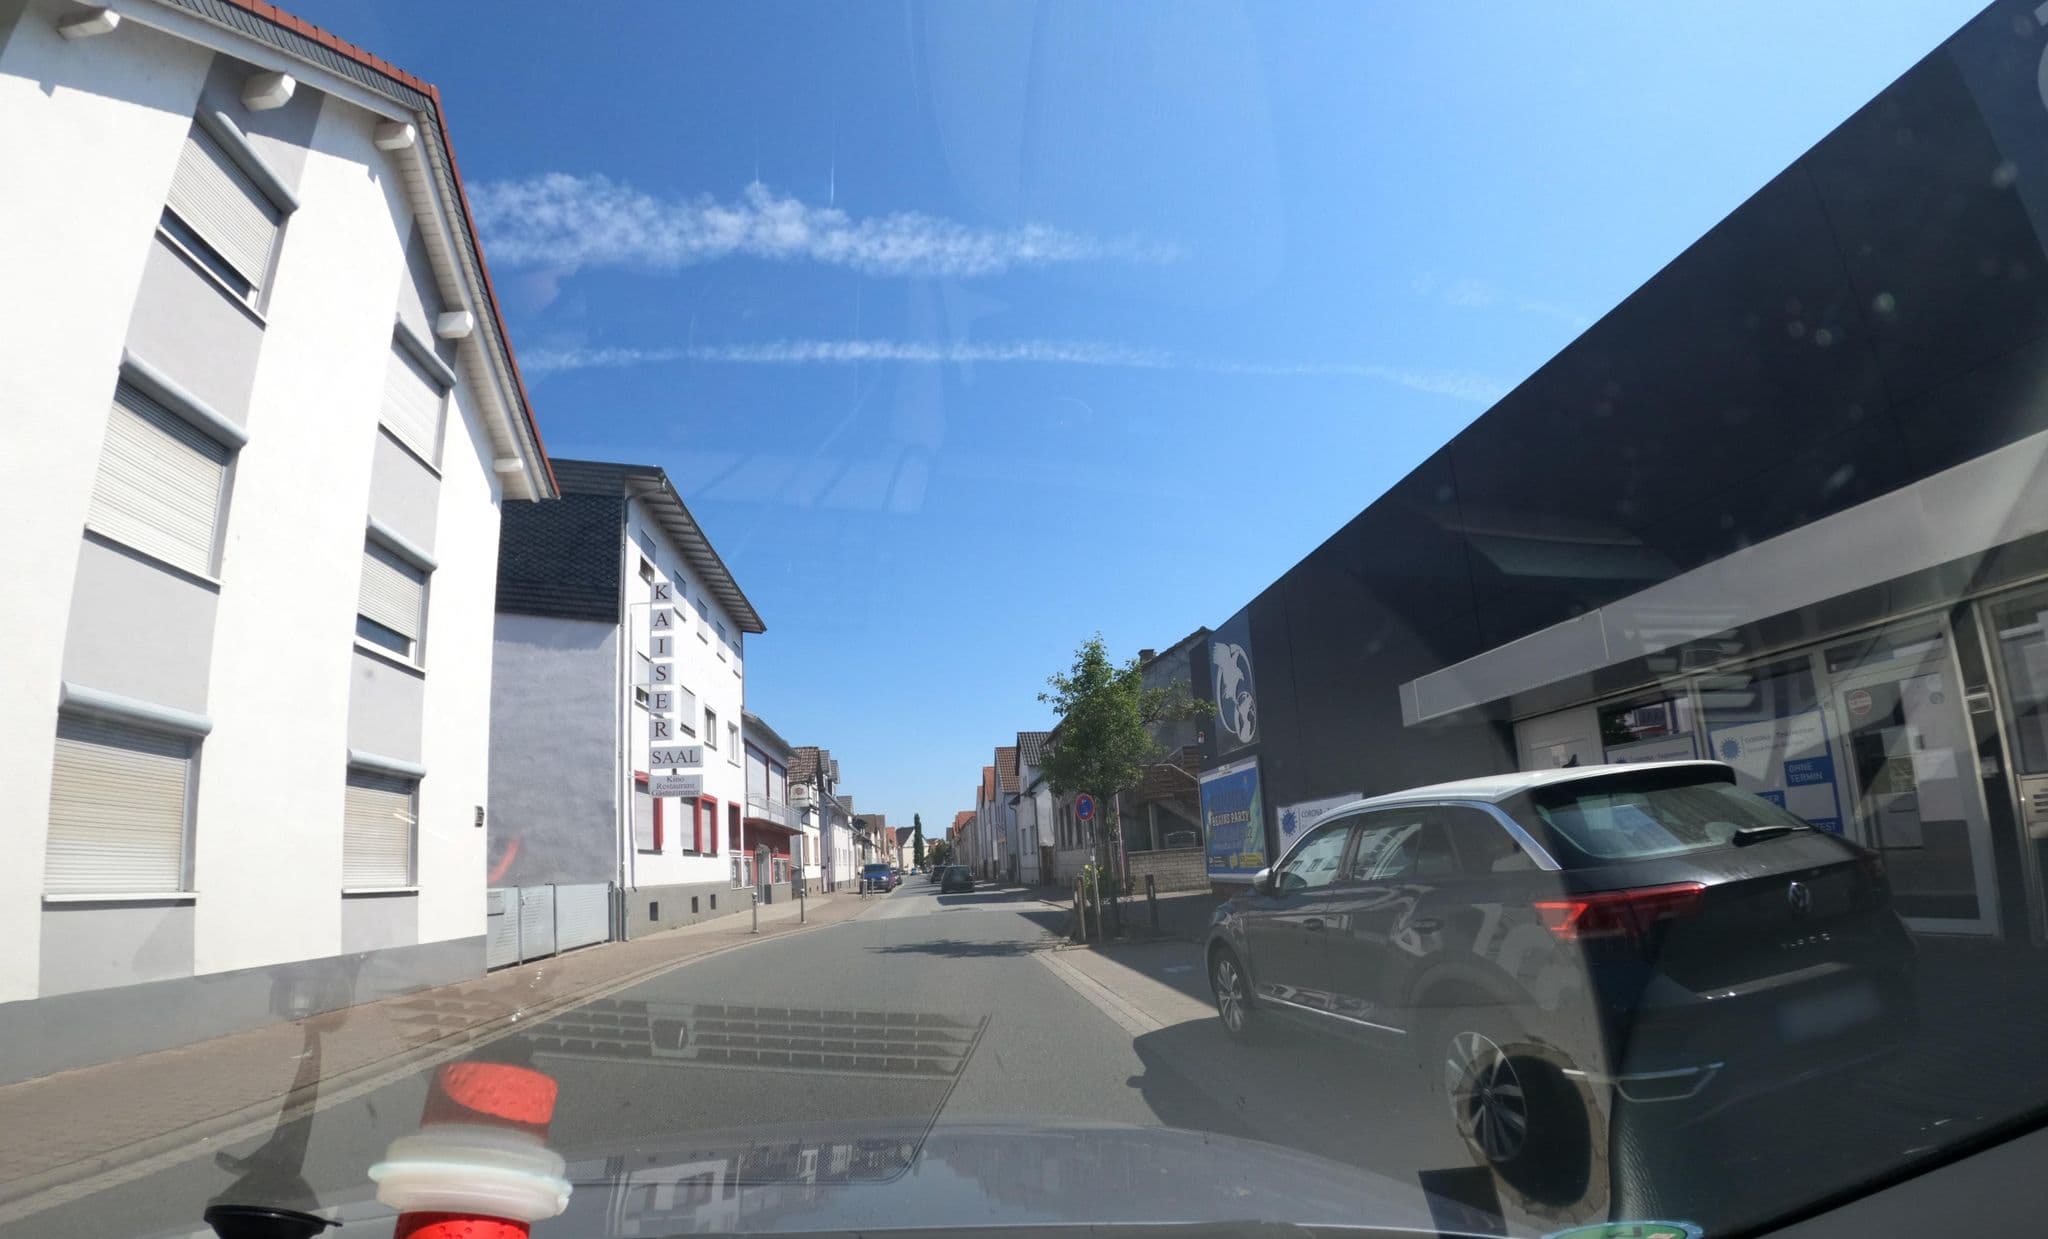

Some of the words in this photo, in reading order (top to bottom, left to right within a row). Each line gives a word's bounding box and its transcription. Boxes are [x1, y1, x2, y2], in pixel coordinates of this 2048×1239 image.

[654, 584, 669, 737] KAISER
[652, 749, 699, 764] SAAL
[1788, 762, 1814, 773] OHNE
[1790, 772, 1823, 783] TERMIN
